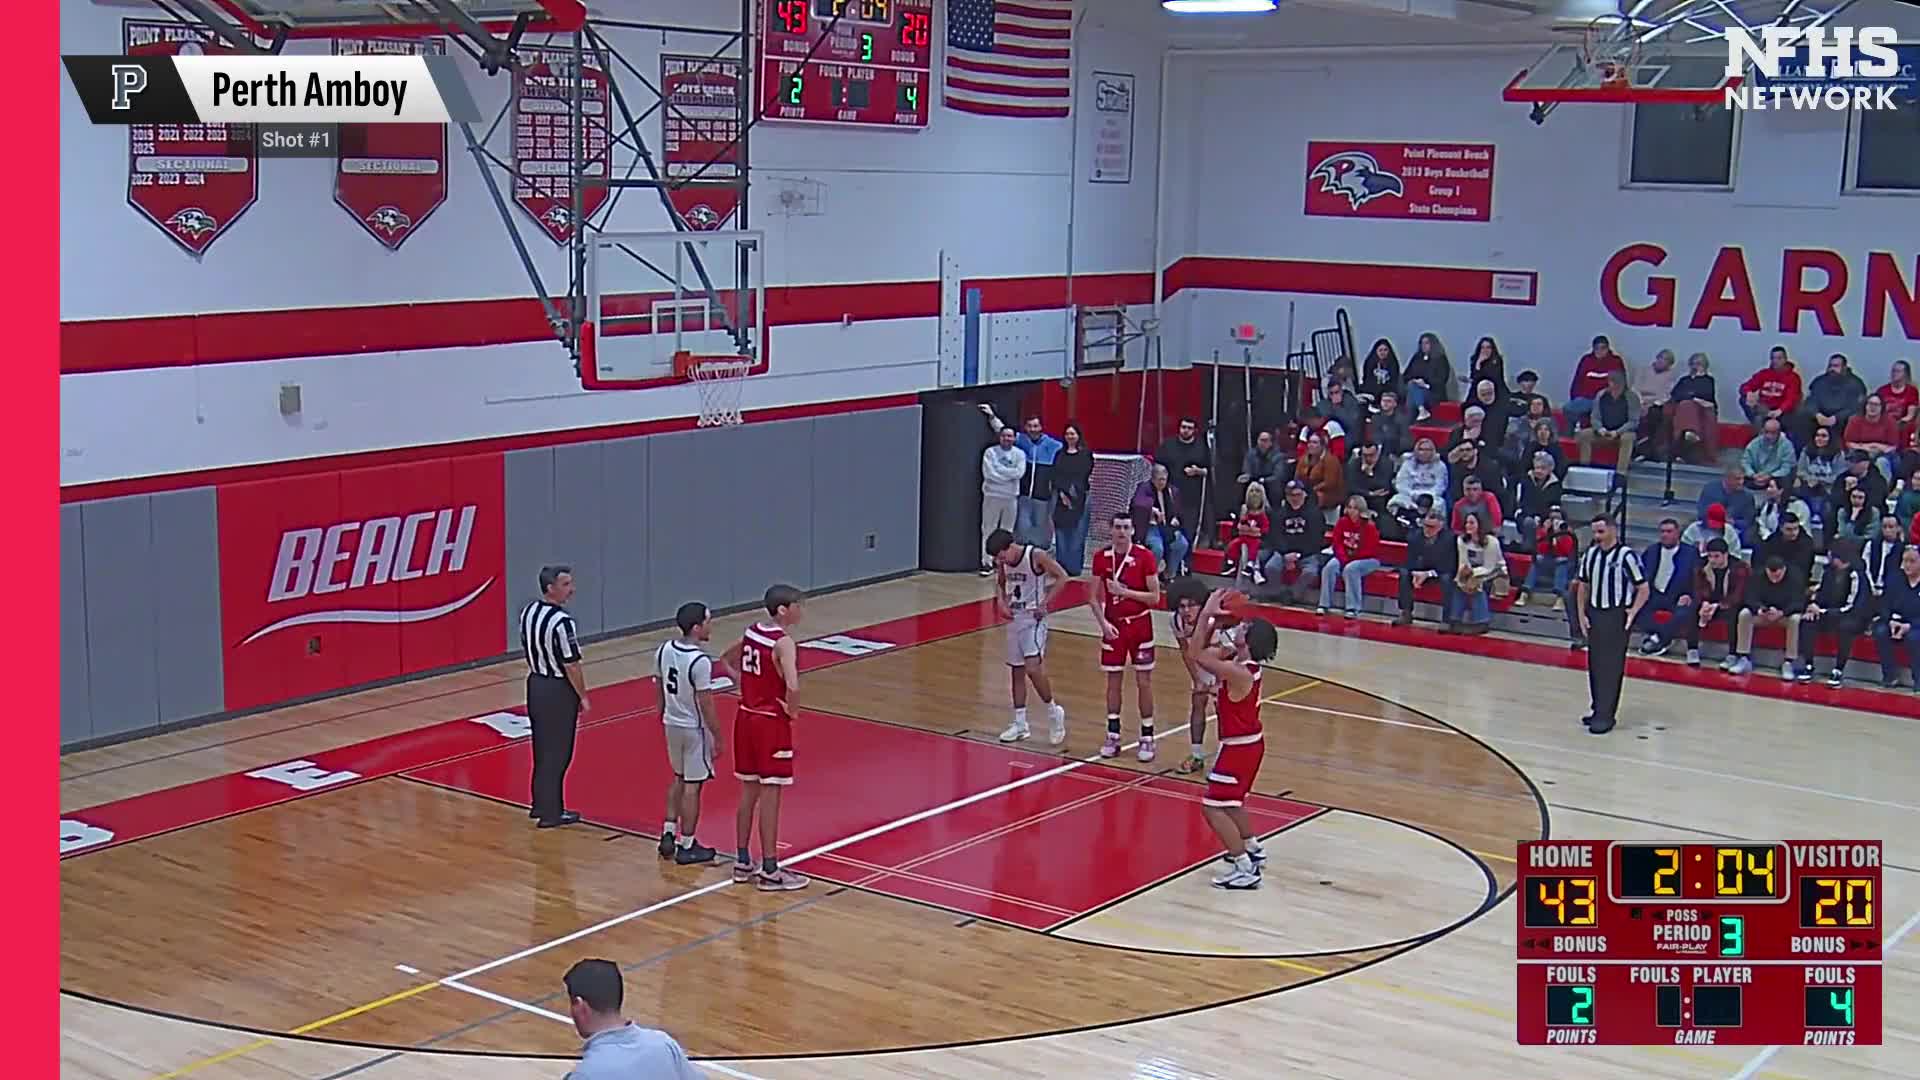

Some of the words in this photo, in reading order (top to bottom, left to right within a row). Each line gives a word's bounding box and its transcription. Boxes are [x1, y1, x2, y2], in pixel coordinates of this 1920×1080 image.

[778, 0, 808, 33] 43
[129, 26, 160, 46] POINT
[902, 12, 928, 47] 20
[862, 34, 873, 60] 3
[779, 62, 803, 74] FOUS
[791, 77, 803, 103] 2
[907, 87, 917, 110] 4
[158, 129, 180, 141] 2021
[132, 143, 155, 154] 2025
[1403, 148, 1425, 158] Point
[1427, 149, 1462, 159] Pleasant
[1464, 149, 1489, 160] Beach
[1424, 168, 1443, 178] Boys
[1445, 168, 1489, 178] Basketball
[1429, 186, 1454, 197] Group
[1409, 203, 1430, 214] State
[1432, 203, 1477, 216] Champions
[1600, 244, 1920, 341] GARN
[268, 505, 477, 602] BEACH
[742, 645, 760, 675] 23
[667, 667, 678, 695] 5
